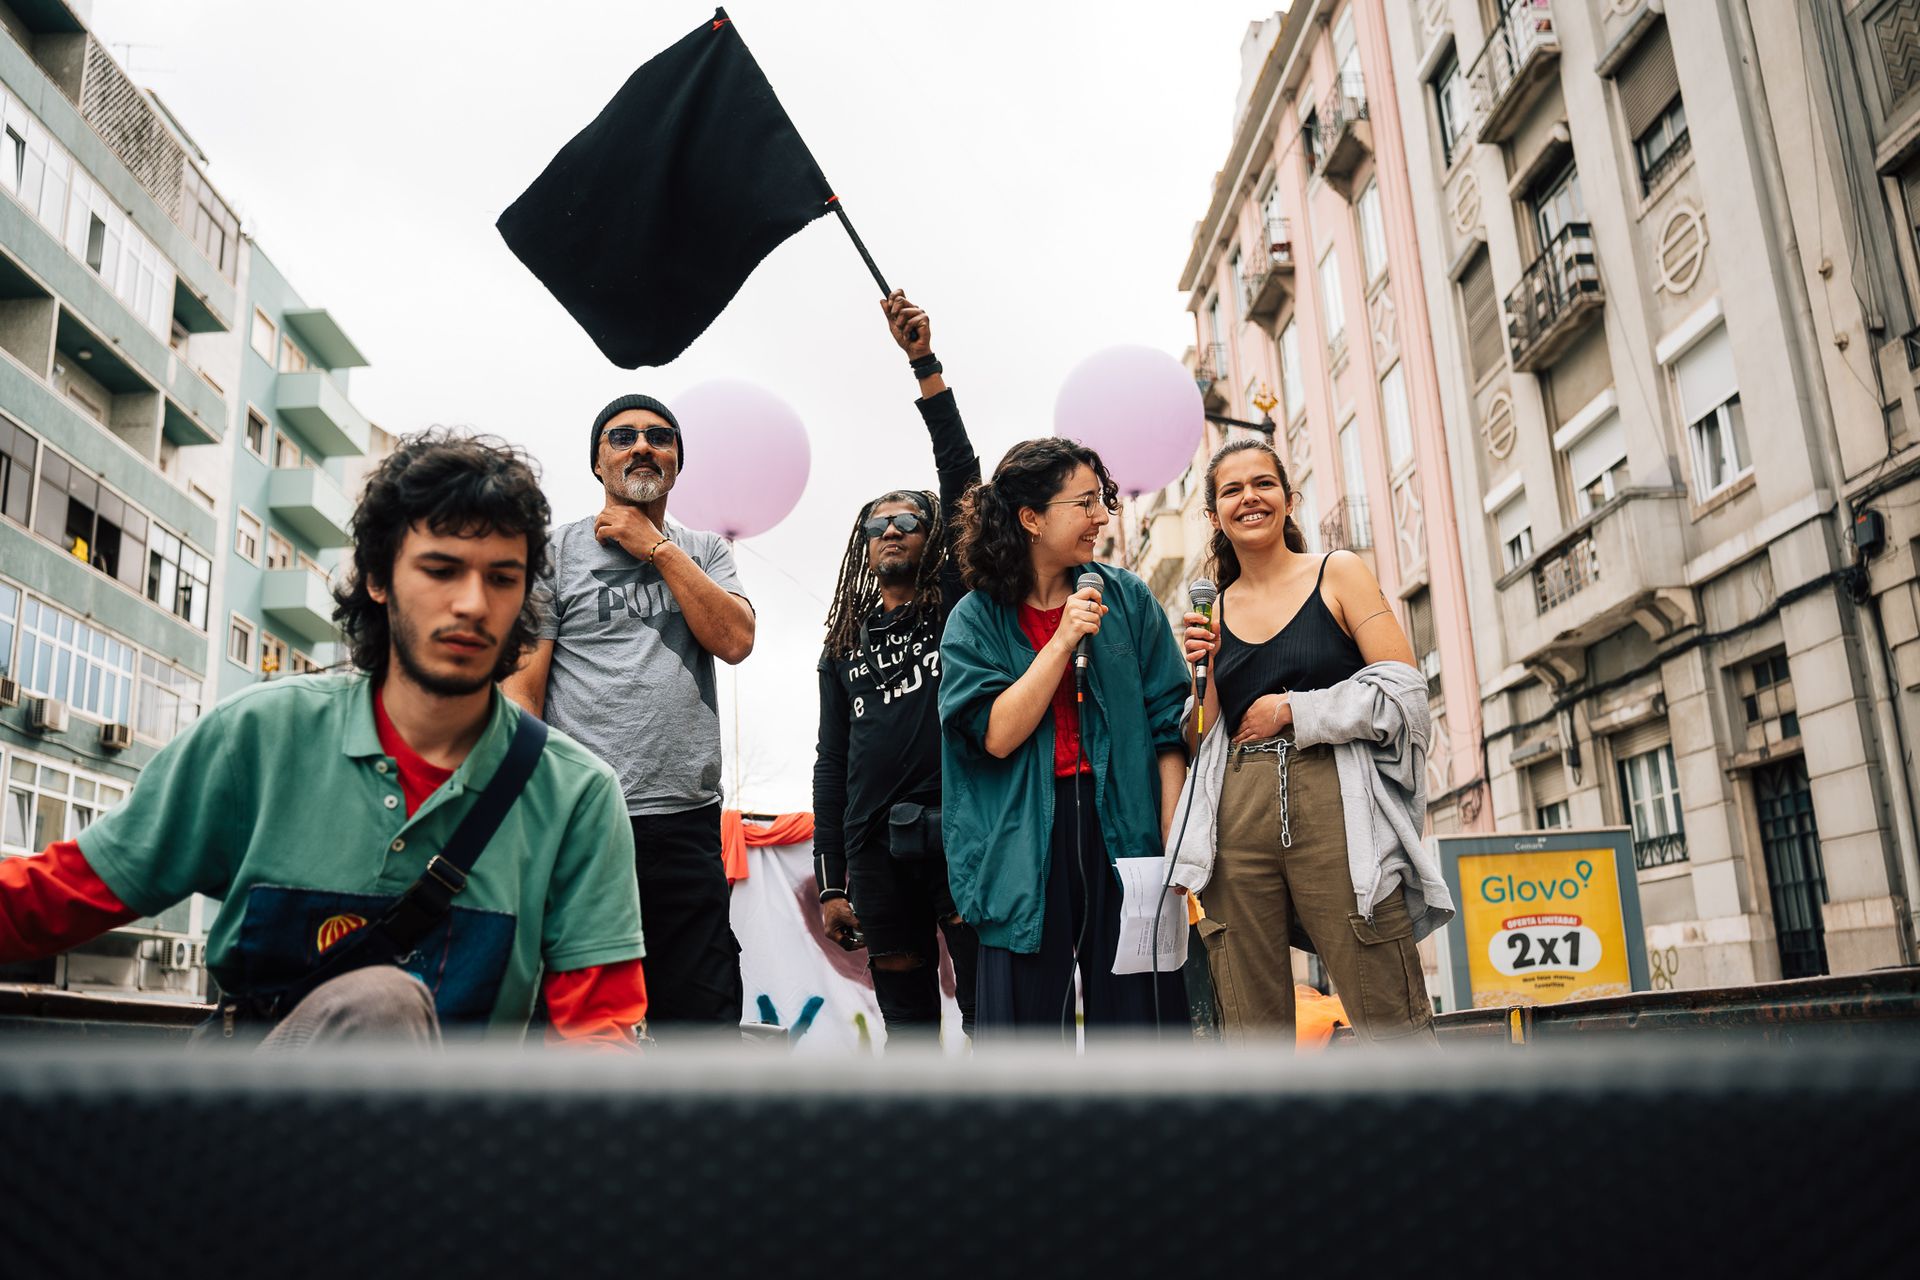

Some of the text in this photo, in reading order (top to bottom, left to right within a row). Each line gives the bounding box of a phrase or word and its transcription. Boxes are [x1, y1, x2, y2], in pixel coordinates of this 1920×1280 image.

[1480, 874, 1580, 903] Glovo
[1506, 916, 1537, 929] OFERTA
[1507, 931, 1581, 970] 2x1
